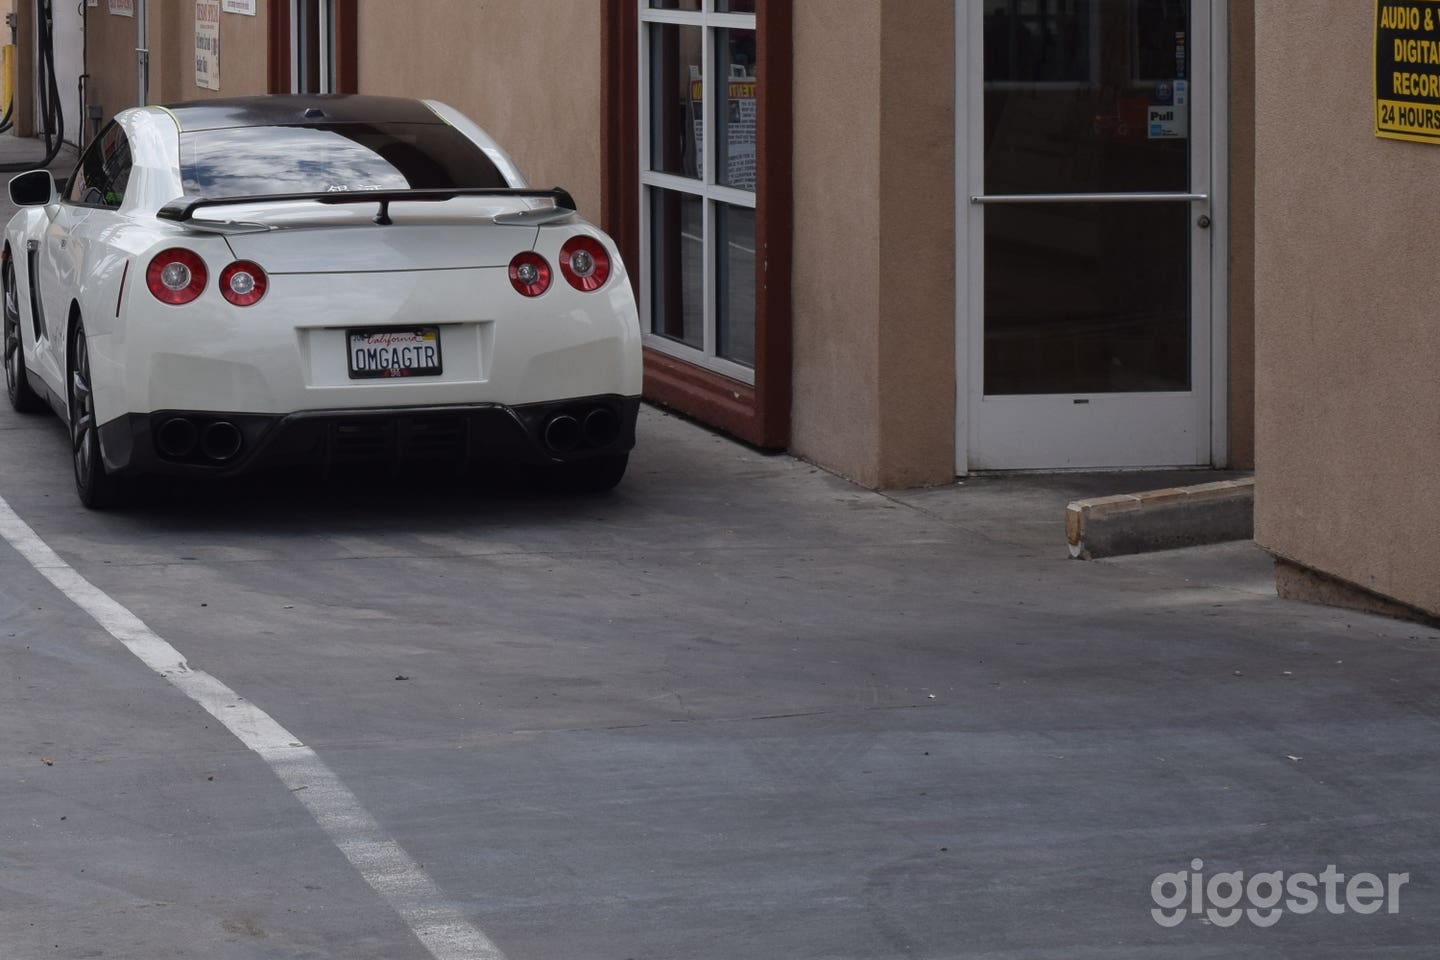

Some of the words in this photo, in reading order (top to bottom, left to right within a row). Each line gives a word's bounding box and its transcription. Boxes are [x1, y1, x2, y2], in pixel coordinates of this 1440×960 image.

[1380, 6, 1420, 31] AUDIO
[1424, 8, 1434, 32] &
[1150, 111, 1174, 121] Pull
[1382, 104, 1395, 124] 24
[1399, 106, 1440, 130] HOURS
[368, 334, 417, 346] California
[356, 346, 436, 370] OMGAGTR
